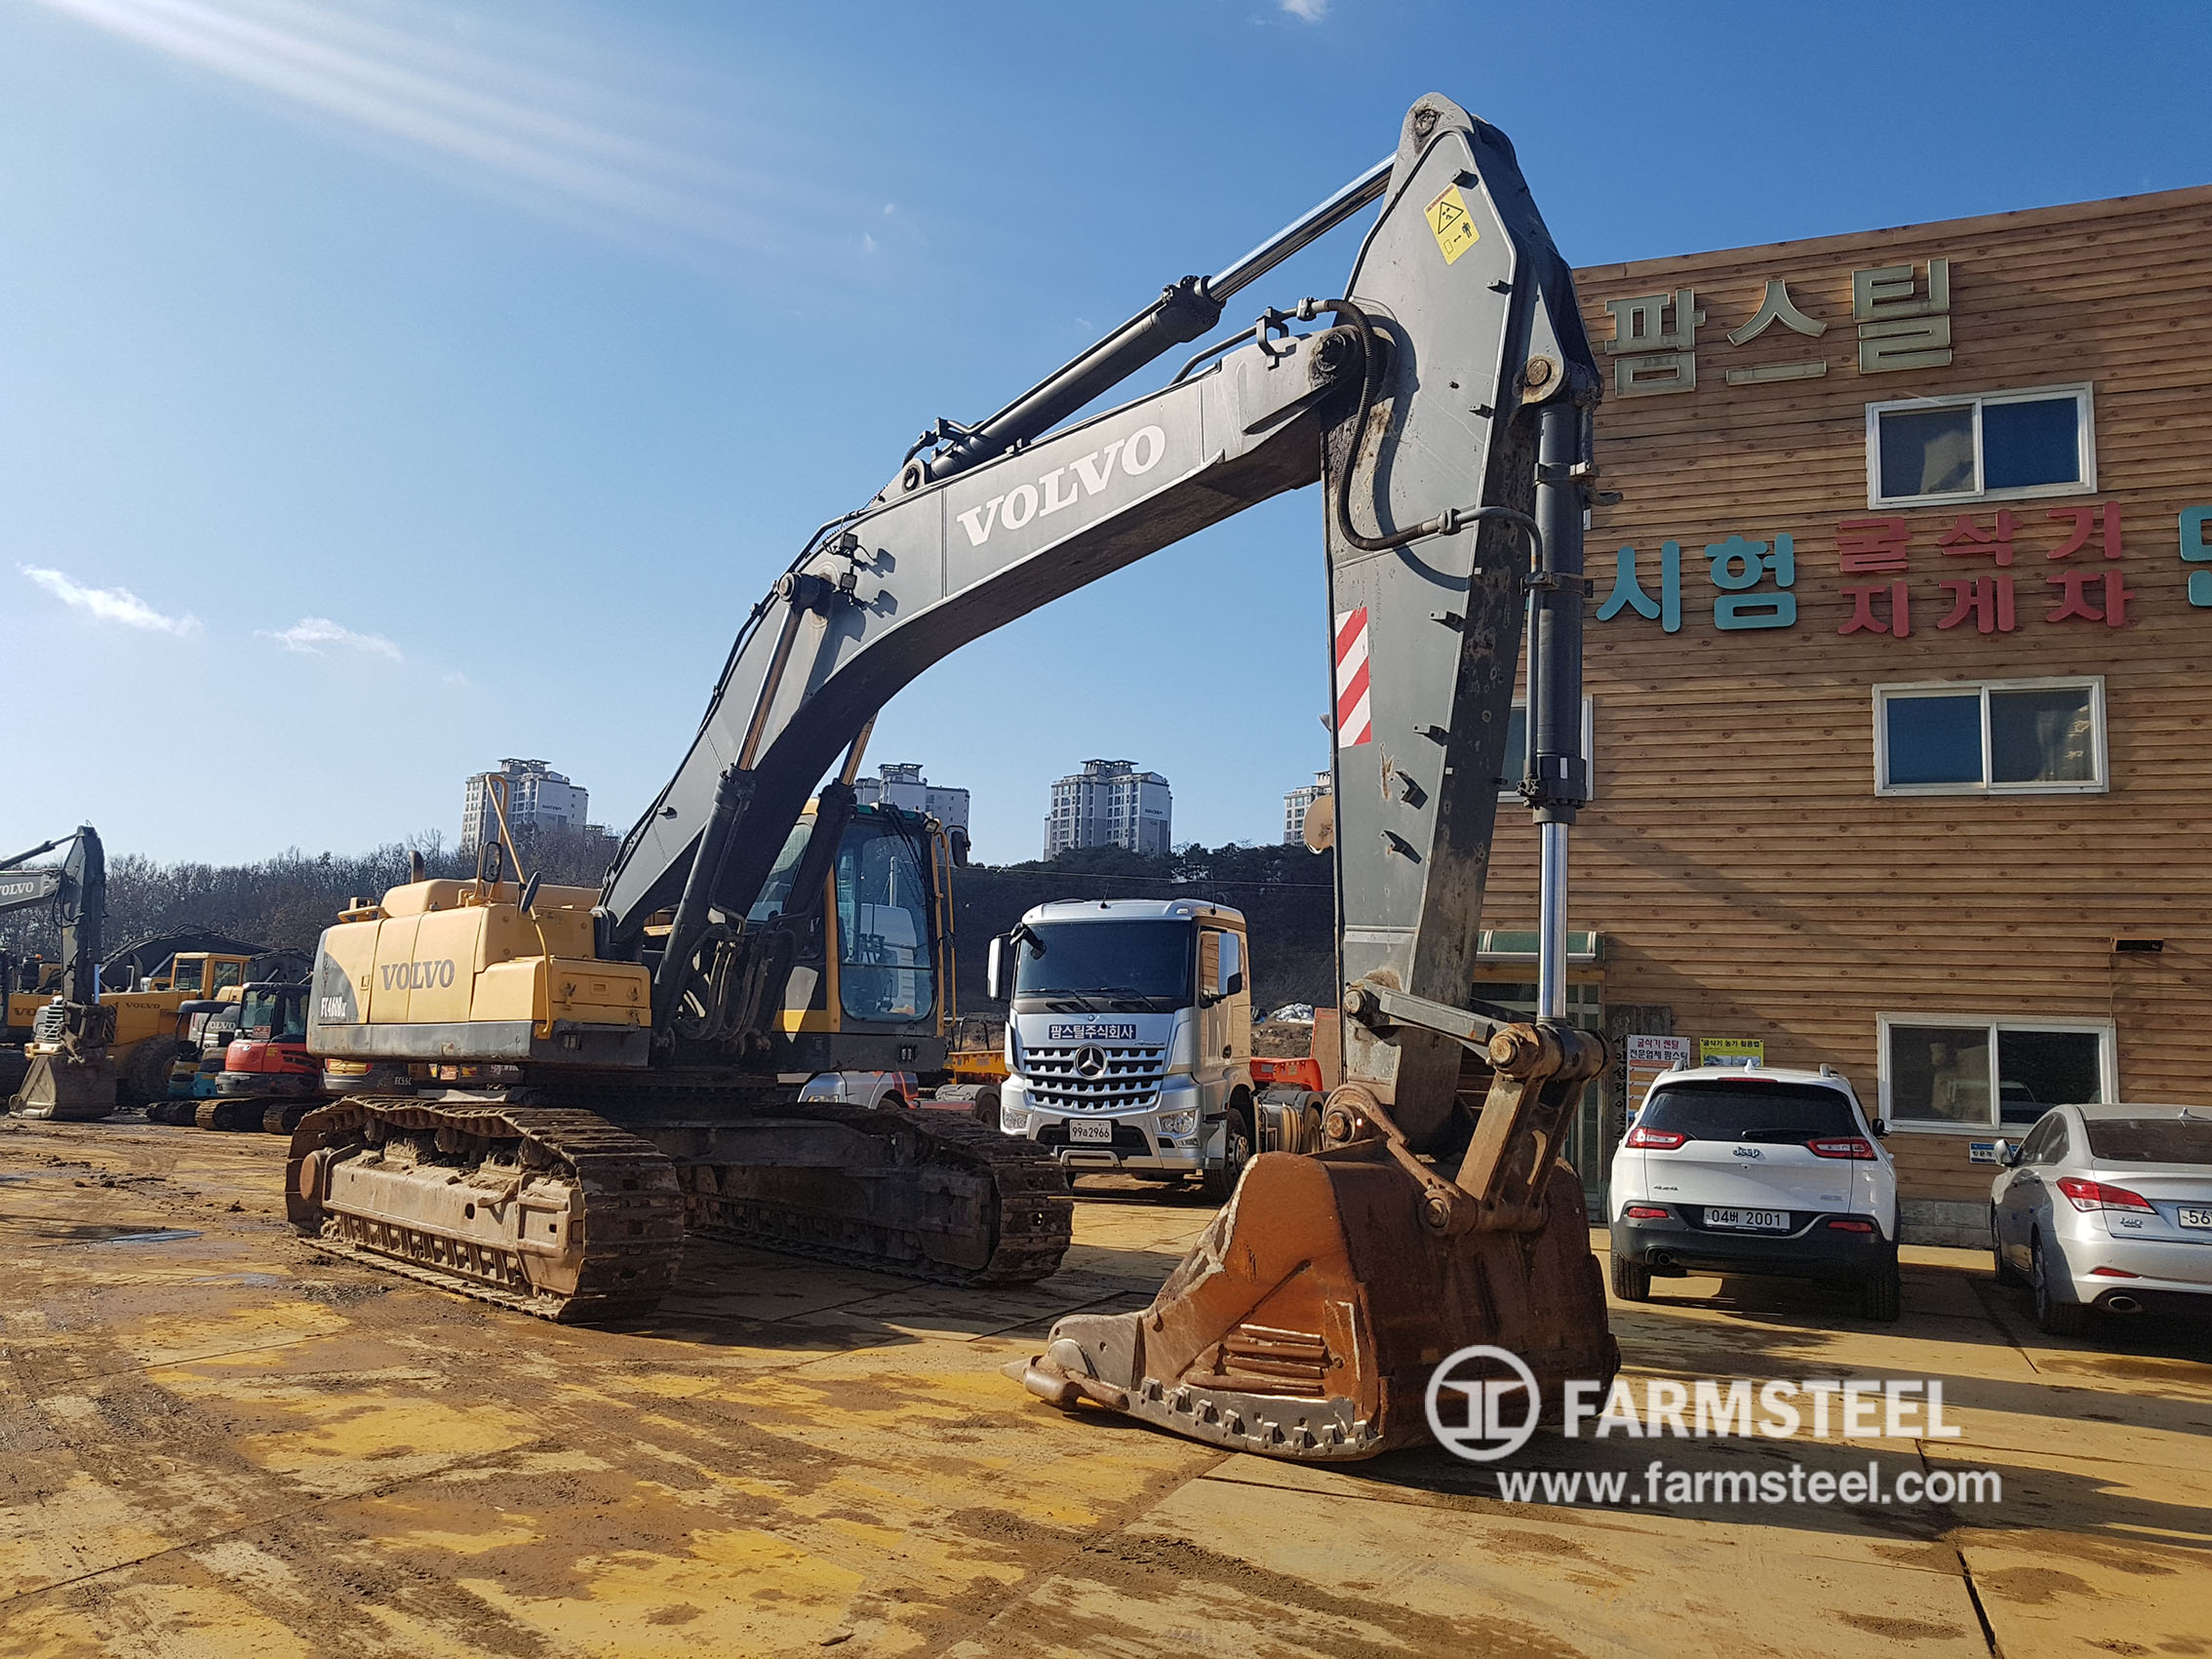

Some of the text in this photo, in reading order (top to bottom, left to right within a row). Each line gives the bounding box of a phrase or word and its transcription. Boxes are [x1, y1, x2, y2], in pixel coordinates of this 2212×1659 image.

[1604, 257, 1954, 399] 팜스틸
[956, 425, 1165, 547] VOLVO
[1596, 533, 1797, 633] 시험
[1837, 568, 2135, 638] 지게차
[0, 881, 34, 896] OLVO
[380, 959, 455, 991] VOLVO
[1050, 1025, 1133, 1039] 팜스틸주식회사
[1638, 1038, 1661, 1048] 굴삭기
[1630, 1048, 1662, 1060] 전문업체
[1733, 1147, 1759, 1158] Jeep
[1712, 1209, 1781, 1227] 04버 2001
[2189, 1209, 2212, 1225] 56
